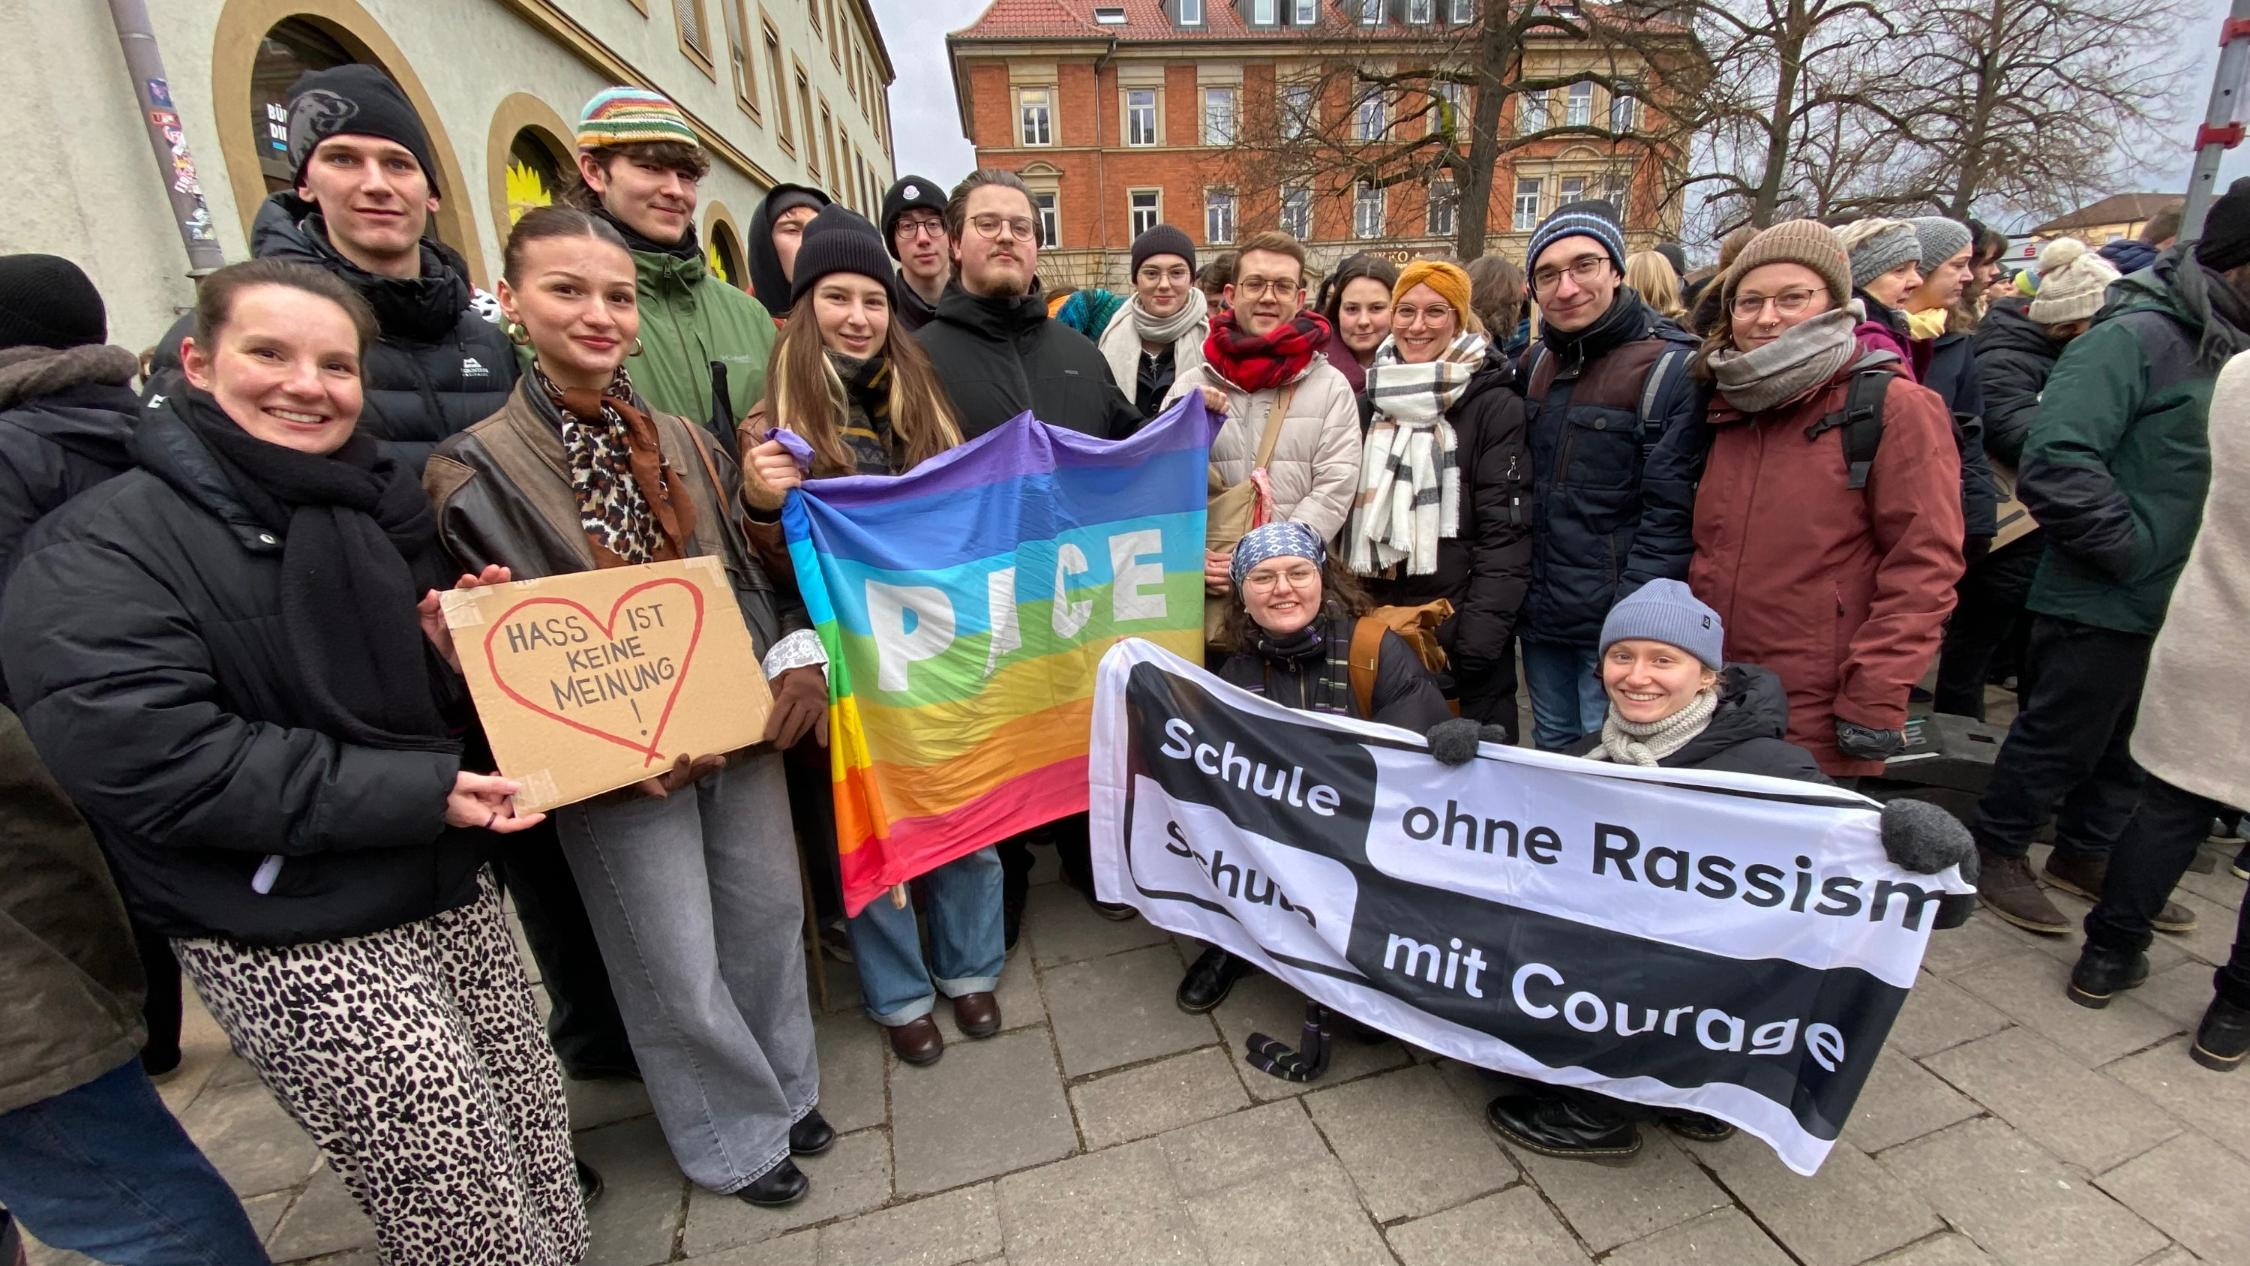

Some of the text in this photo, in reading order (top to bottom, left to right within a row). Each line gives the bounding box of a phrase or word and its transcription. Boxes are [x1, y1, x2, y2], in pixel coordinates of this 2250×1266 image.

[505, 603, 665, 653] HASS IST
[566, 636, 646, 673] KEINE
[549, 656, 675, 711] MEINUNG
[630, 699, 648, 737] !
[1159, 717, 1340, 816] Schule
[1402, 799, 1563, 865] ohne
[1383, 932, 1487, 998] mit
[1511, 962, 1846, 1073] Courage
